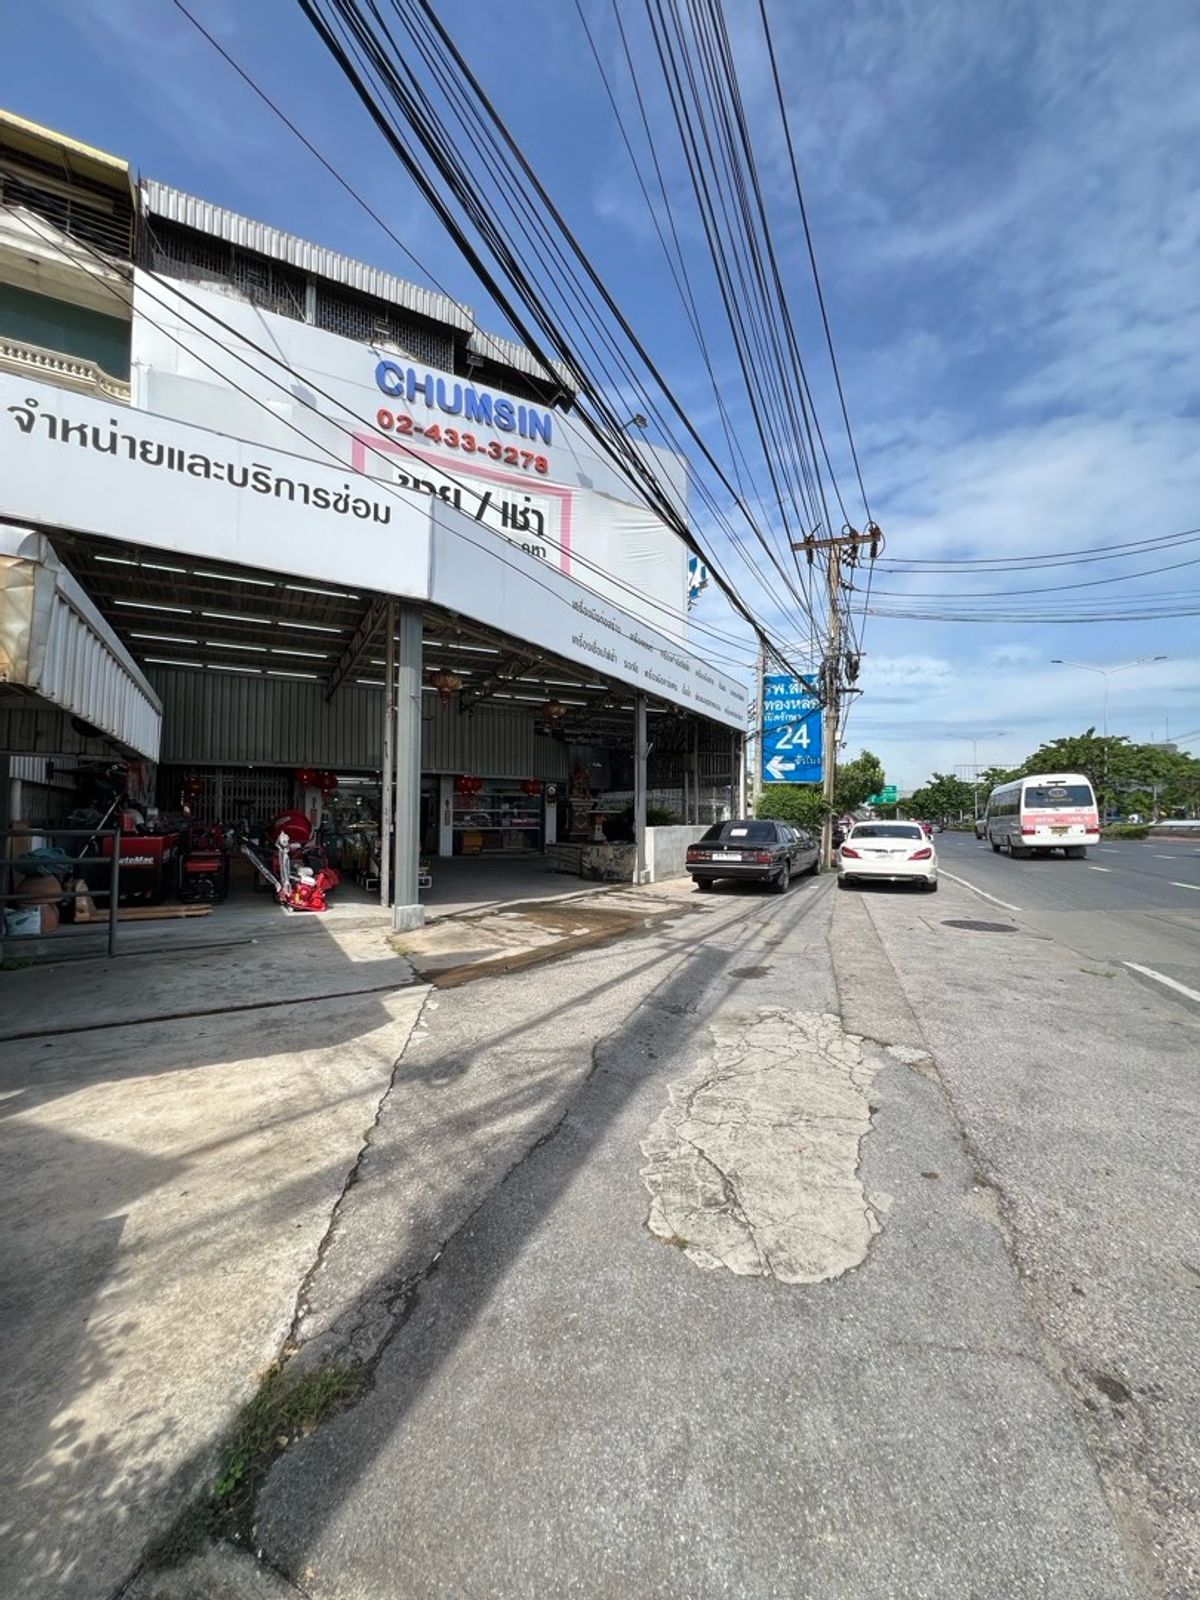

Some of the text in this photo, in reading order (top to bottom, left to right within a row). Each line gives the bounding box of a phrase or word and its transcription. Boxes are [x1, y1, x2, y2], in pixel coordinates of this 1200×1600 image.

[374, 360, 552, 445] CHUMSIN
[7, 398, 391, 525] จำหน่ายและบริการซ่อม
[376, 408, 549, 474] 02-433-3278
[775, 724, 811, 749] 24
[118, 856, 154, 865] utoMac
